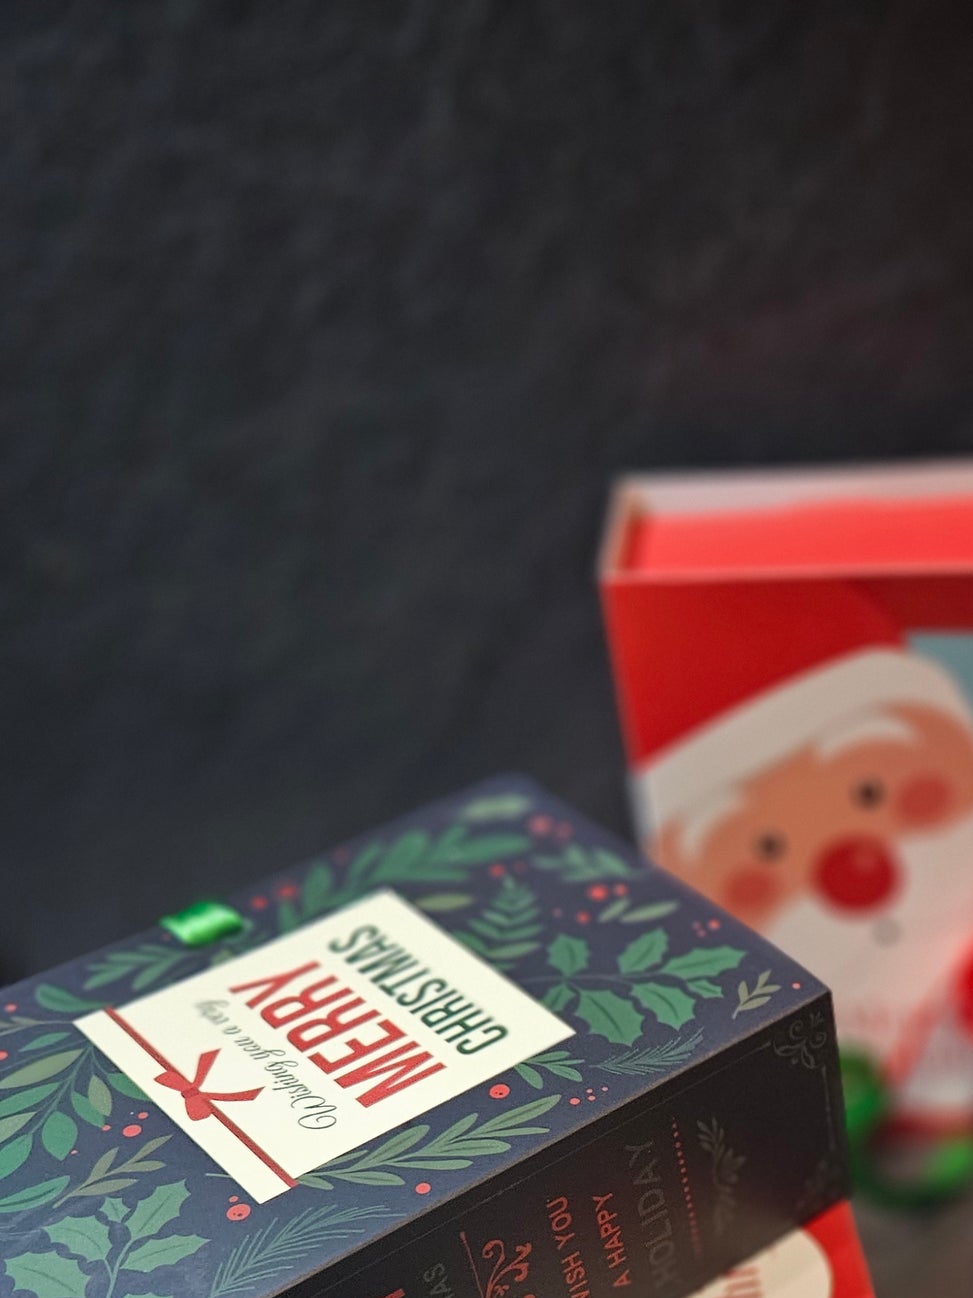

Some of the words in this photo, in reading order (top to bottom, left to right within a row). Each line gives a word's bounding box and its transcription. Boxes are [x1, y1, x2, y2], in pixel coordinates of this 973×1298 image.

[328, 924, 509, 1056] CHRISTMAS
[222, 1024, 242, 1035] a
[228, 960, 448, 1109] MERRY
[233, 1036, 287, 1060] you
[263, 1060, 337, 1130] Wishing
[546, 1196, 576, 1250] YOU
[592, 1192, 627, 1269] HAPPY
[612, 1269, 632, 1287] A
